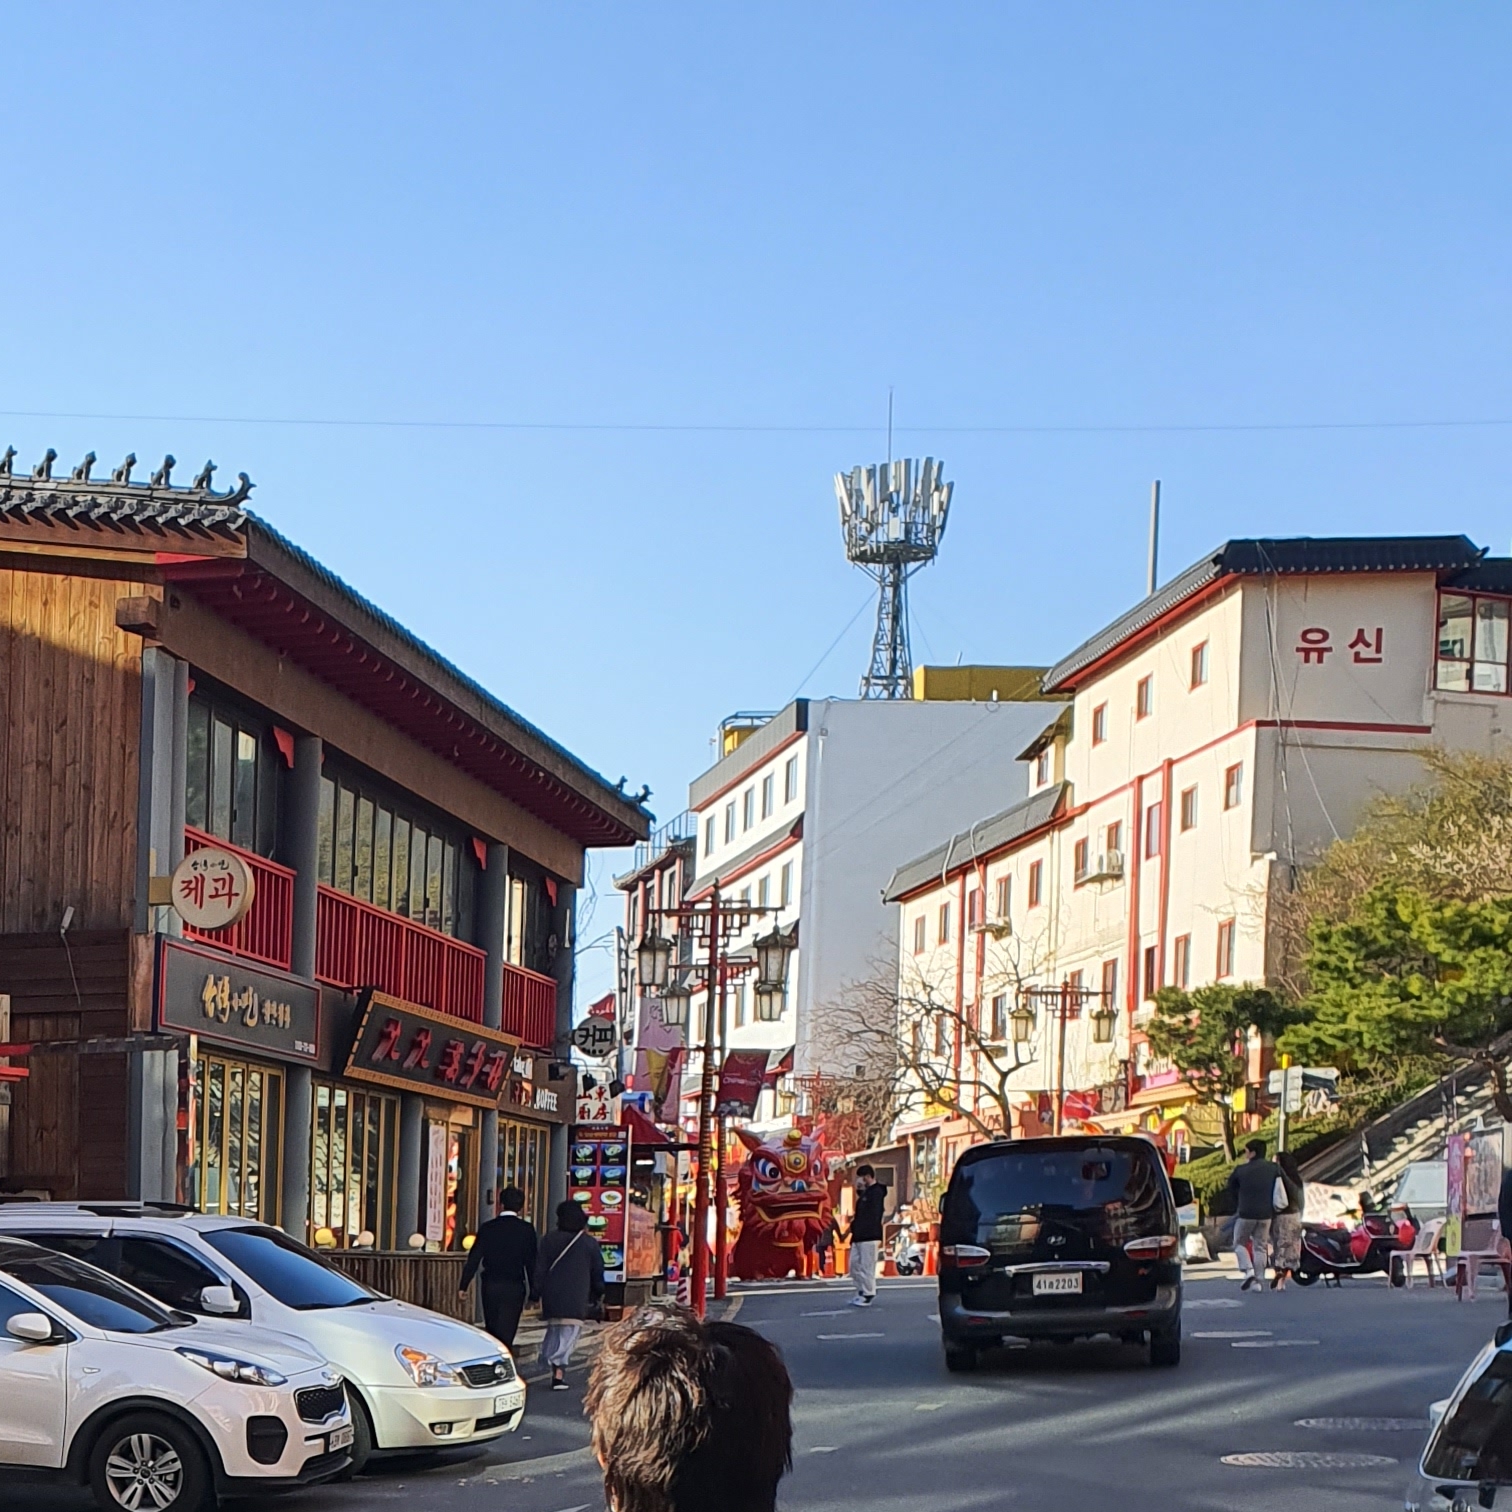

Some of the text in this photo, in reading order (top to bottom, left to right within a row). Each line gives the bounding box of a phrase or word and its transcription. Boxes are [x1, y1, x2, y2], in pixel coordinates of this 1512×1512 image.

[1295, 627, 1383, 664] 유신
[180, 872, 240, 909] 제과
[577, 1024, 615, 1047] 커피
